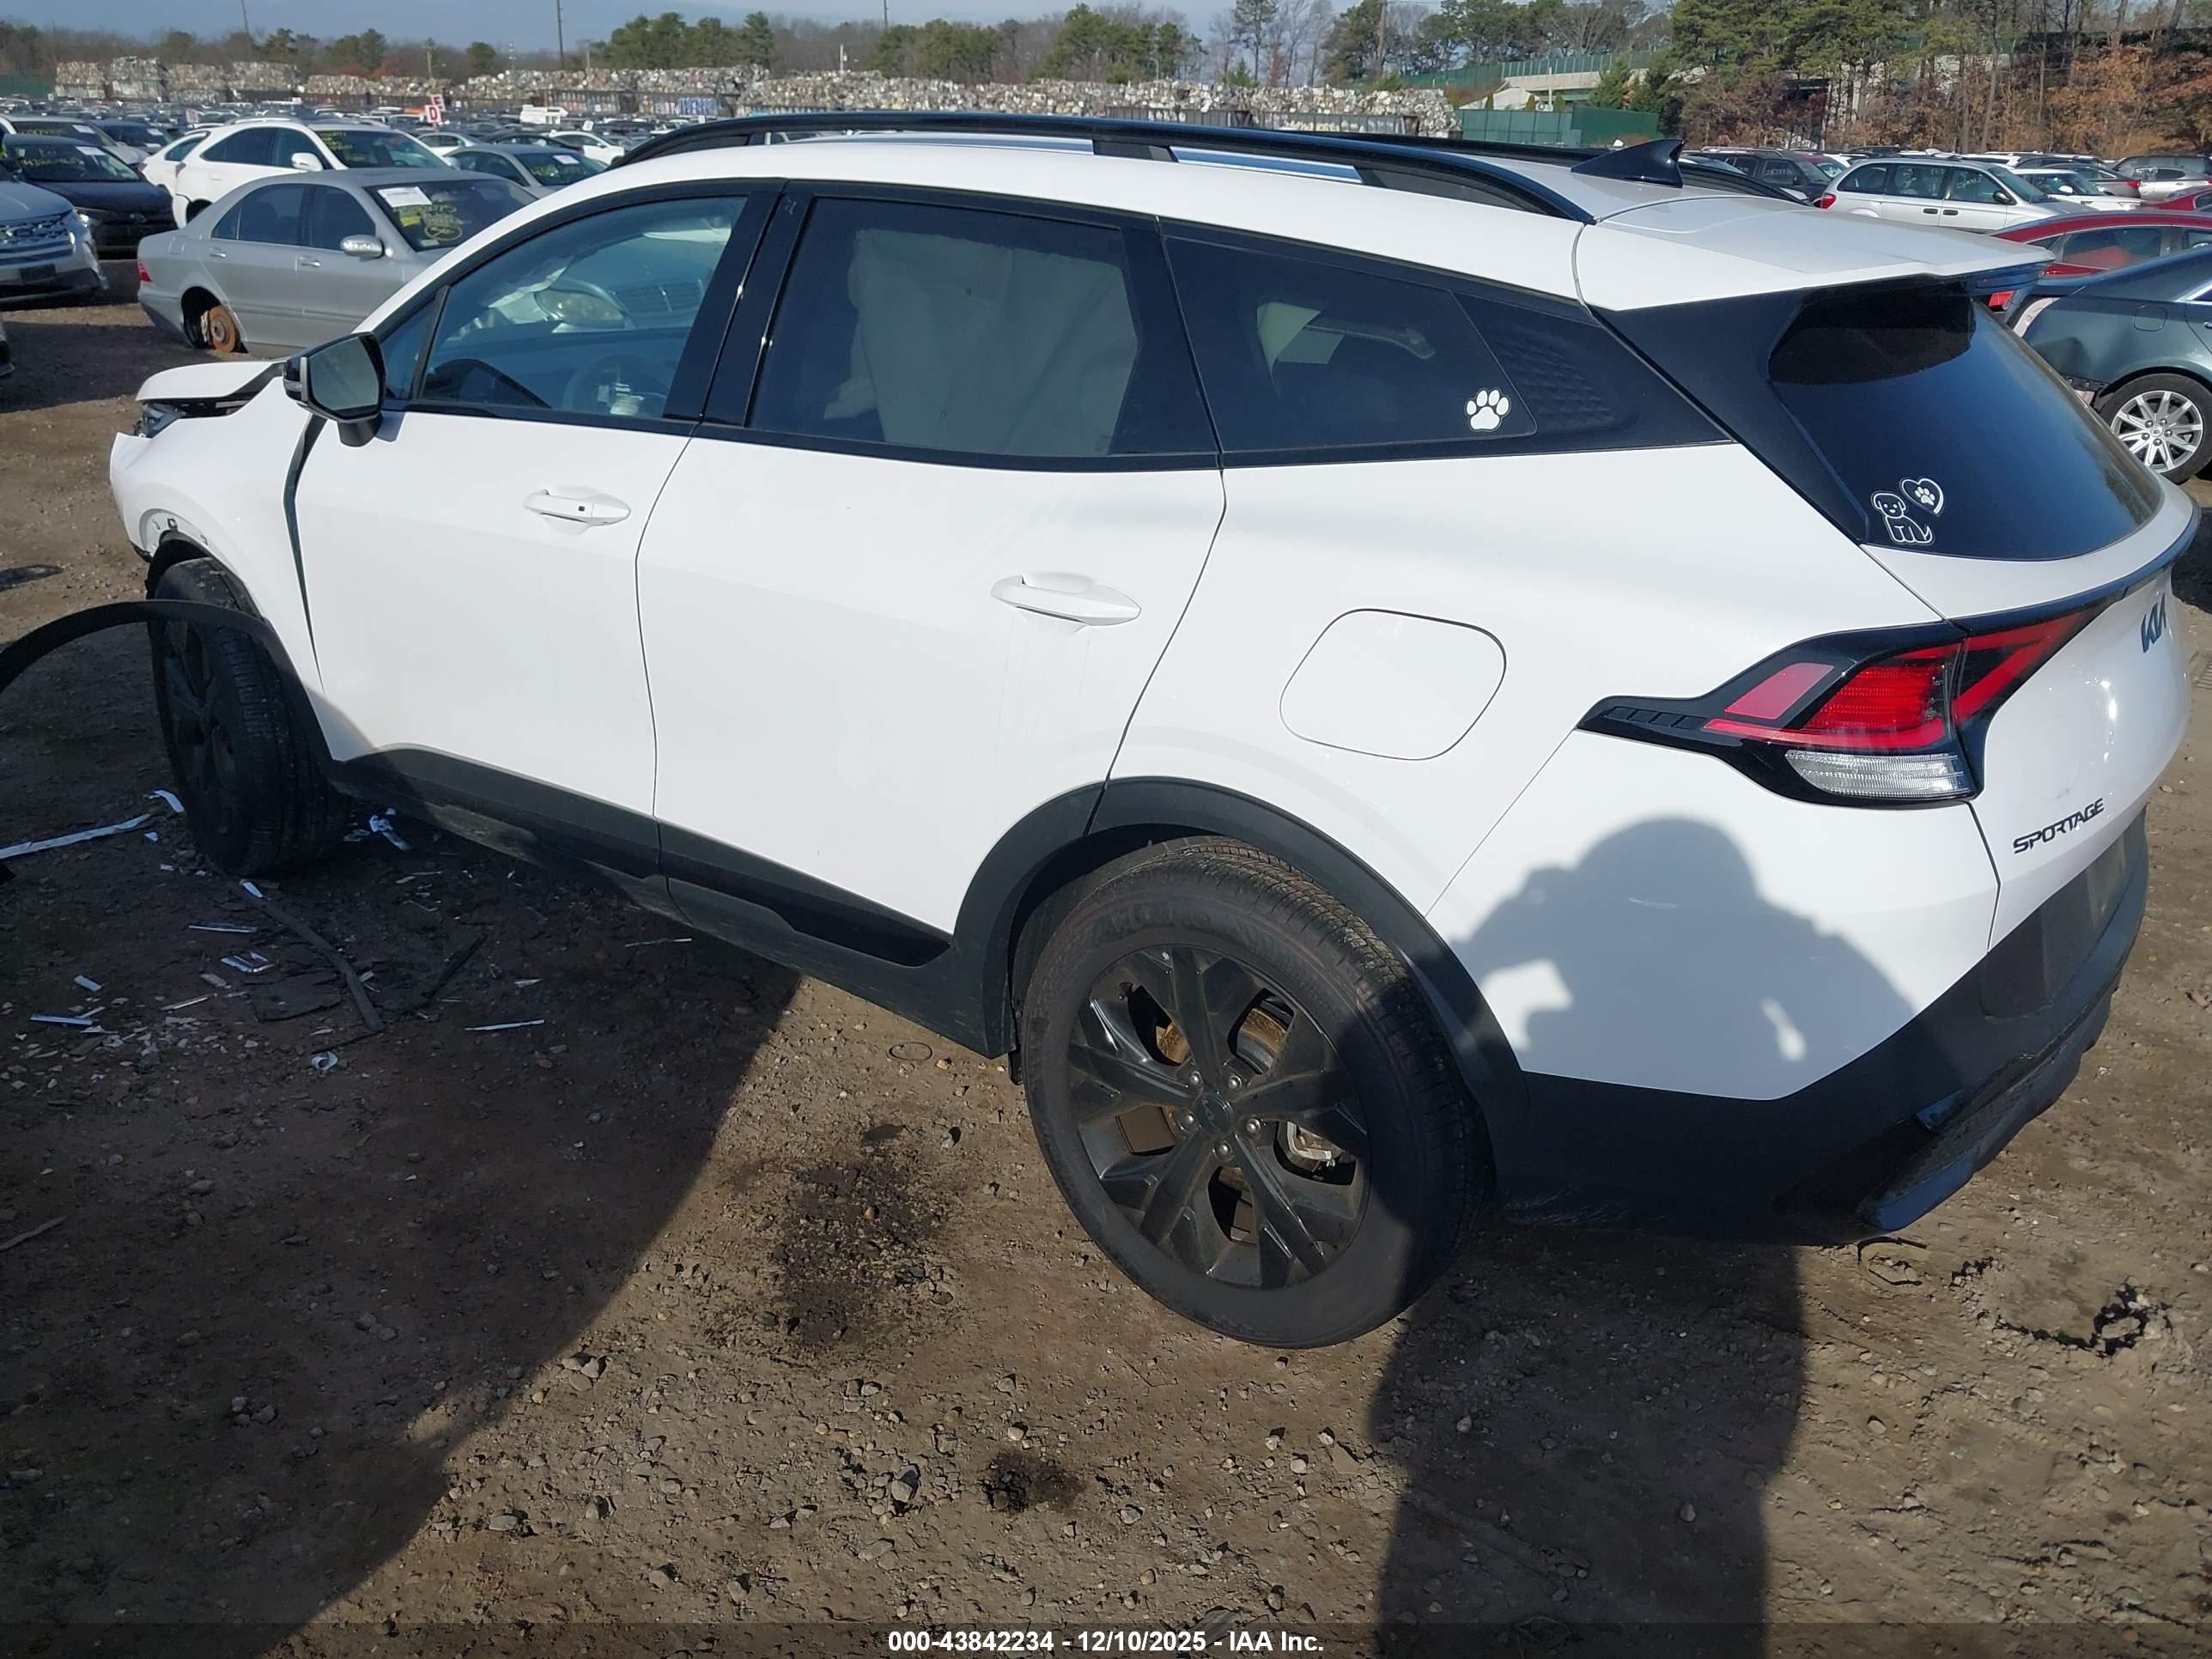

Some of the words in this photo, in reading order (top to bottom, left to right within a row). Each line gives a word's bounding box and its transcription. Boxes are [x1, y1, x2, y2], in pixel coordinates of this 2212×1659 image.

[428, 106, 438, 121] D
[2141, 592, 2166, 653] KIA
[2013, 797, 2105, 854] SPORTAGE
